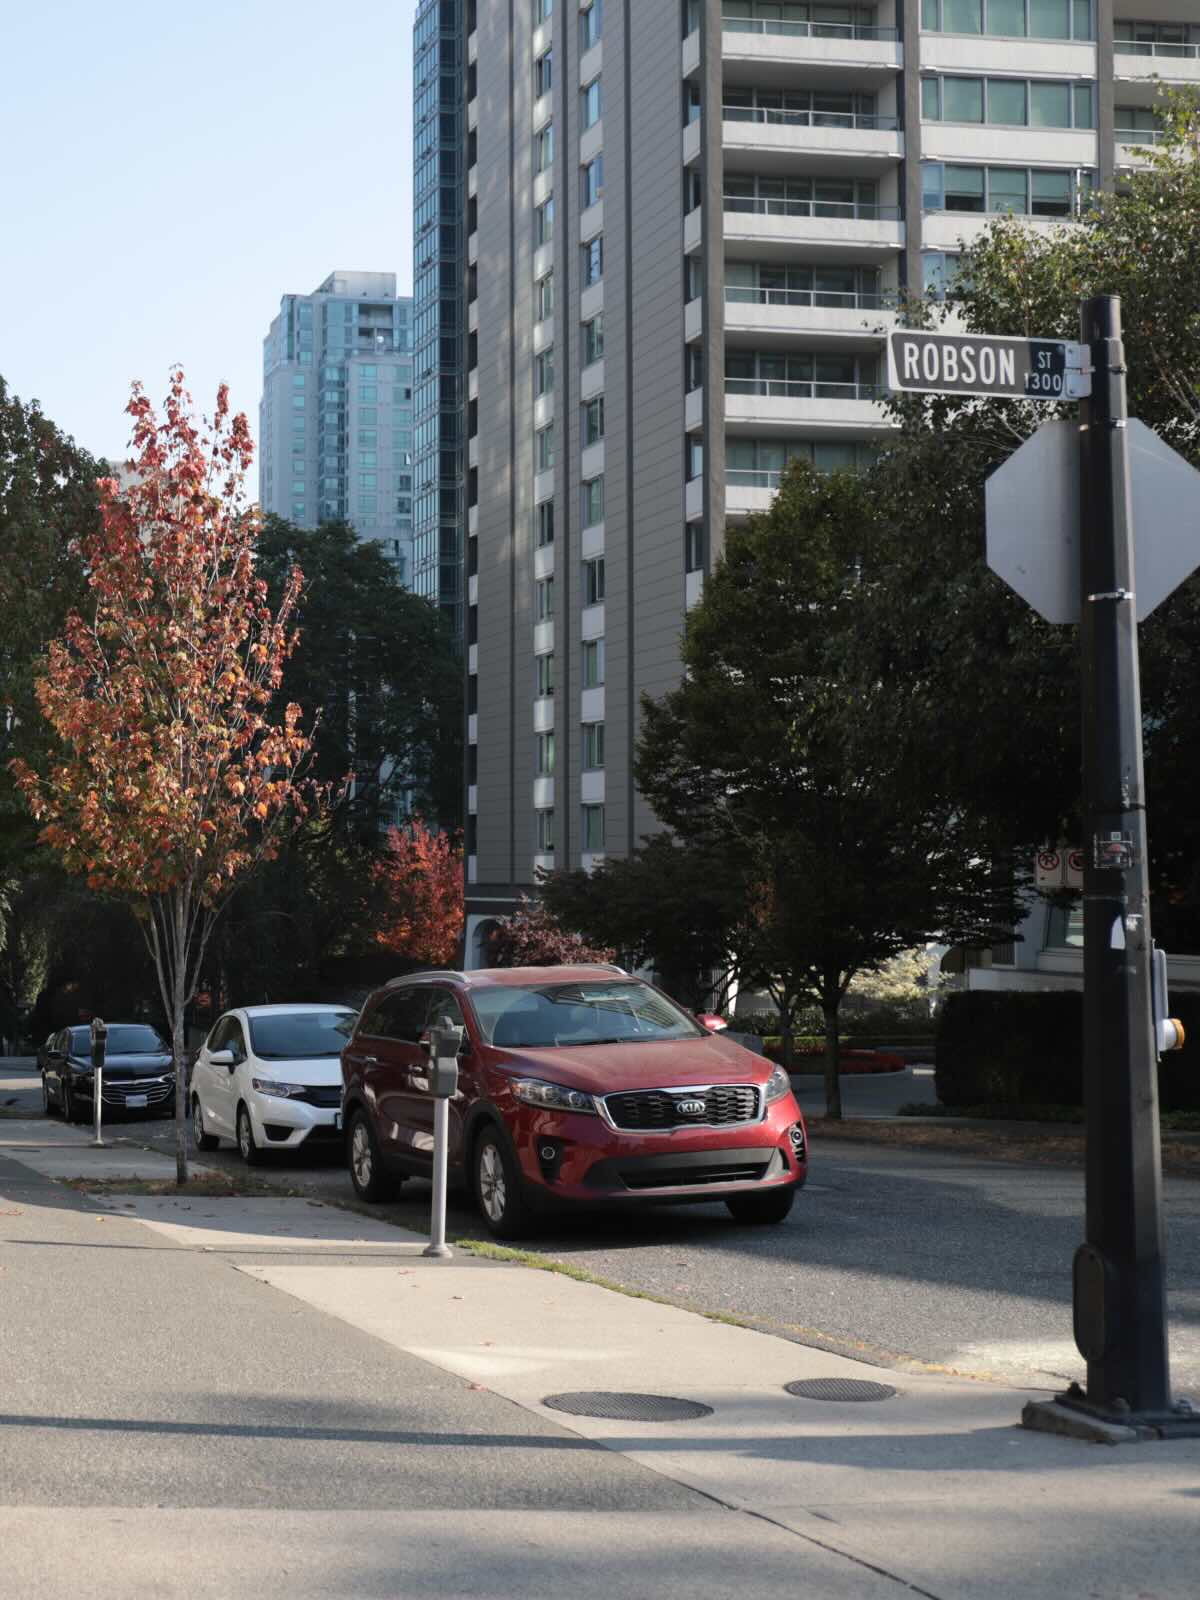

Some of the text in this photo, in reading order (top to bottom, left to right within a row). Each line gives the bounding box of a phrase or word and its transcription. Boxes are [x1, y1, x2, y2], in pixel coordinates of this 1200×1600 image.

[903, 342, 1052, 385] ROBSON ST
[1024, 372, 1062, 391] 1300
[680, 1102, 701, 1113] KIA
